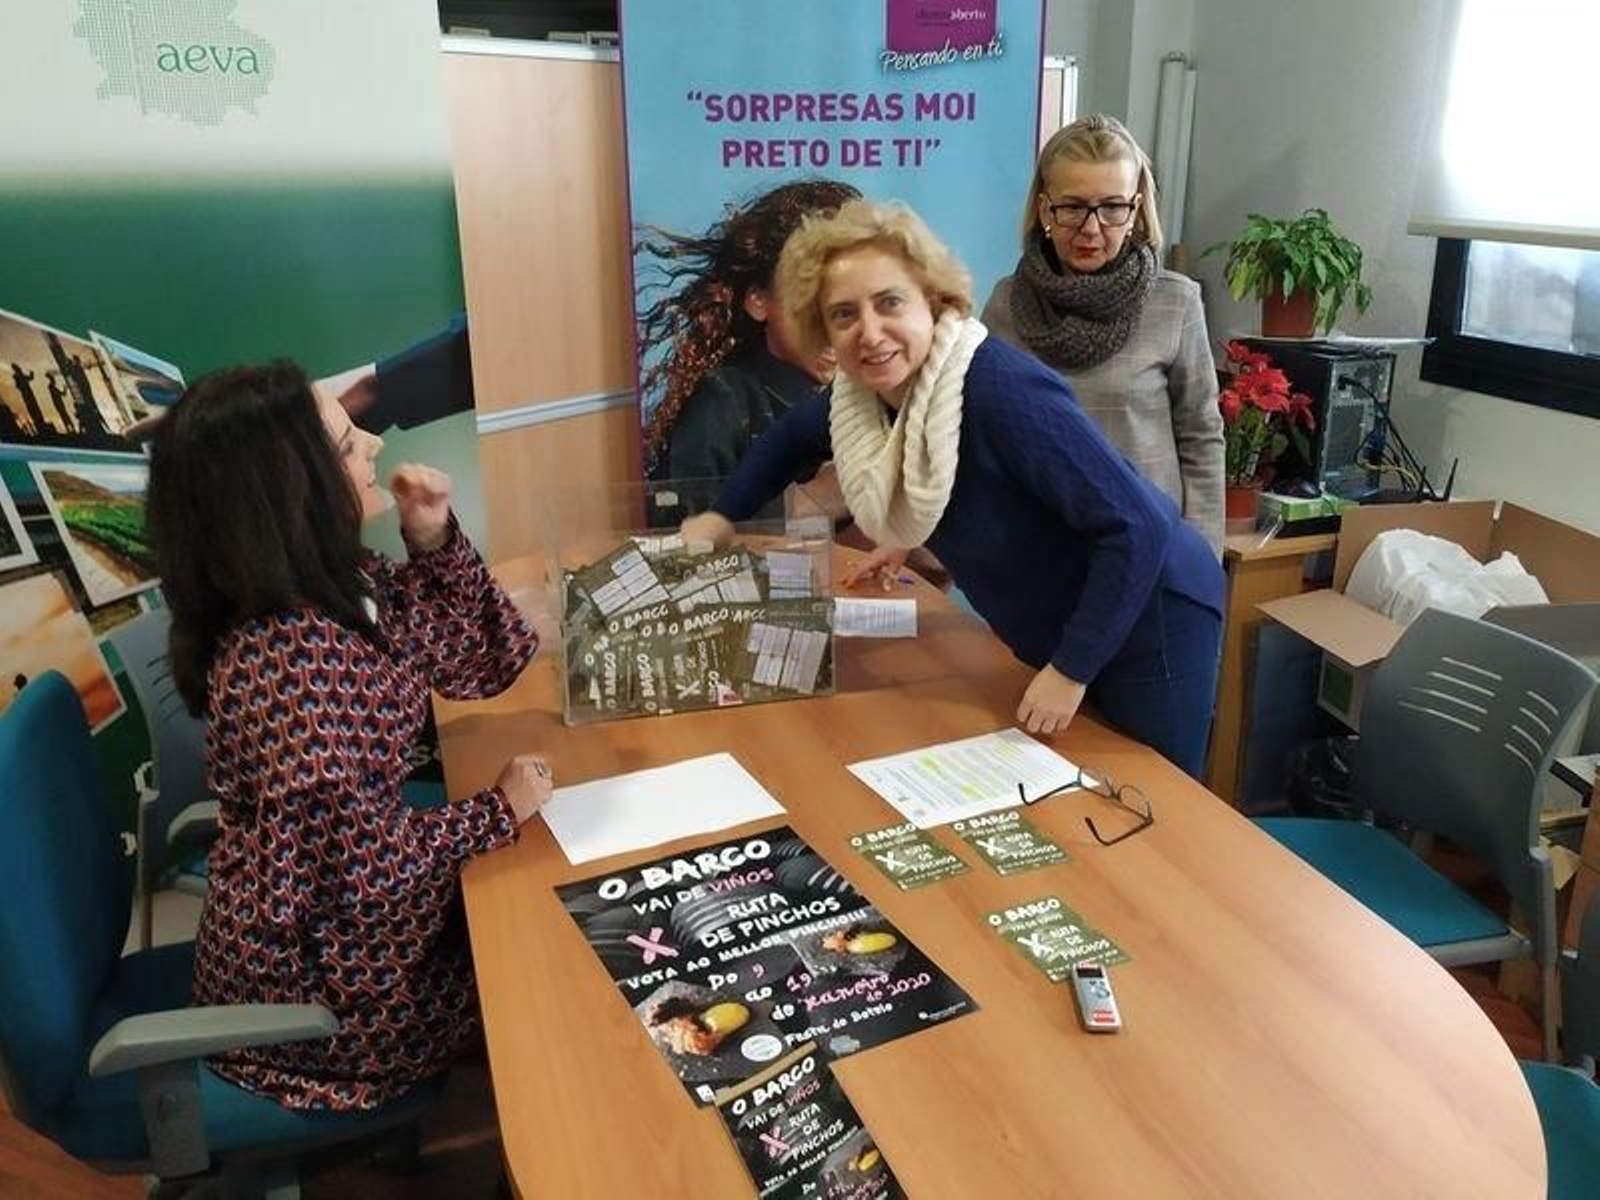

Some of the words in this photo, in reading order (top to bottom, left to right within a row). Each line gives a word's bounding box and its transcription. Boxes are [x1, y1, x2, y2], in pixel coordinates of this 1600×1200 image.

[156, 43, 259, 75] aeva
[879, 36, 958, 72] Pensando
[963, 44, 982, 61] en
[687, 90, 904, 122] “SORPRESAS
[915, 93, 976, 121] MOI
[722, 140, 830, 168] PRETO
[840, 140, 881, 166] DE
[893, 139, 941, 167] TI”
[684, 607, 729, 633] BARCO
[598, 878, 629, 901] O
[640, 838, 772, 891] BARCO
[632, 894, 673, 916] VAI
[676, 885, 707, 904] DE
[709, 867, 775, 895] VIÑOS
[727, 892, 789, 919] RUTA
[700, 926, 736, 949] DE
[738, 896, 841, 937] PINCHOS
[626, 966, 679, 990] VOTA
[686, 956, 711, 973] AO
[718, 932, 784, 962] MELLOR
[752, 962, 765, 979] 9
[886, 972, 932, 997] 2020
[771, 1003, 795, 1021] de
[732, 1098, 747, 1115] O
[752, 1056, 815, 1106] BARCO
[745, 1112, 768, 1130] VAI
[769, 1102, 786, 1119] DE
[789, 1102, 821, 1128] RUTA
[802, 1118, 821, 1136] DE
[791, 1118, 845, 1161] PINCHOS
